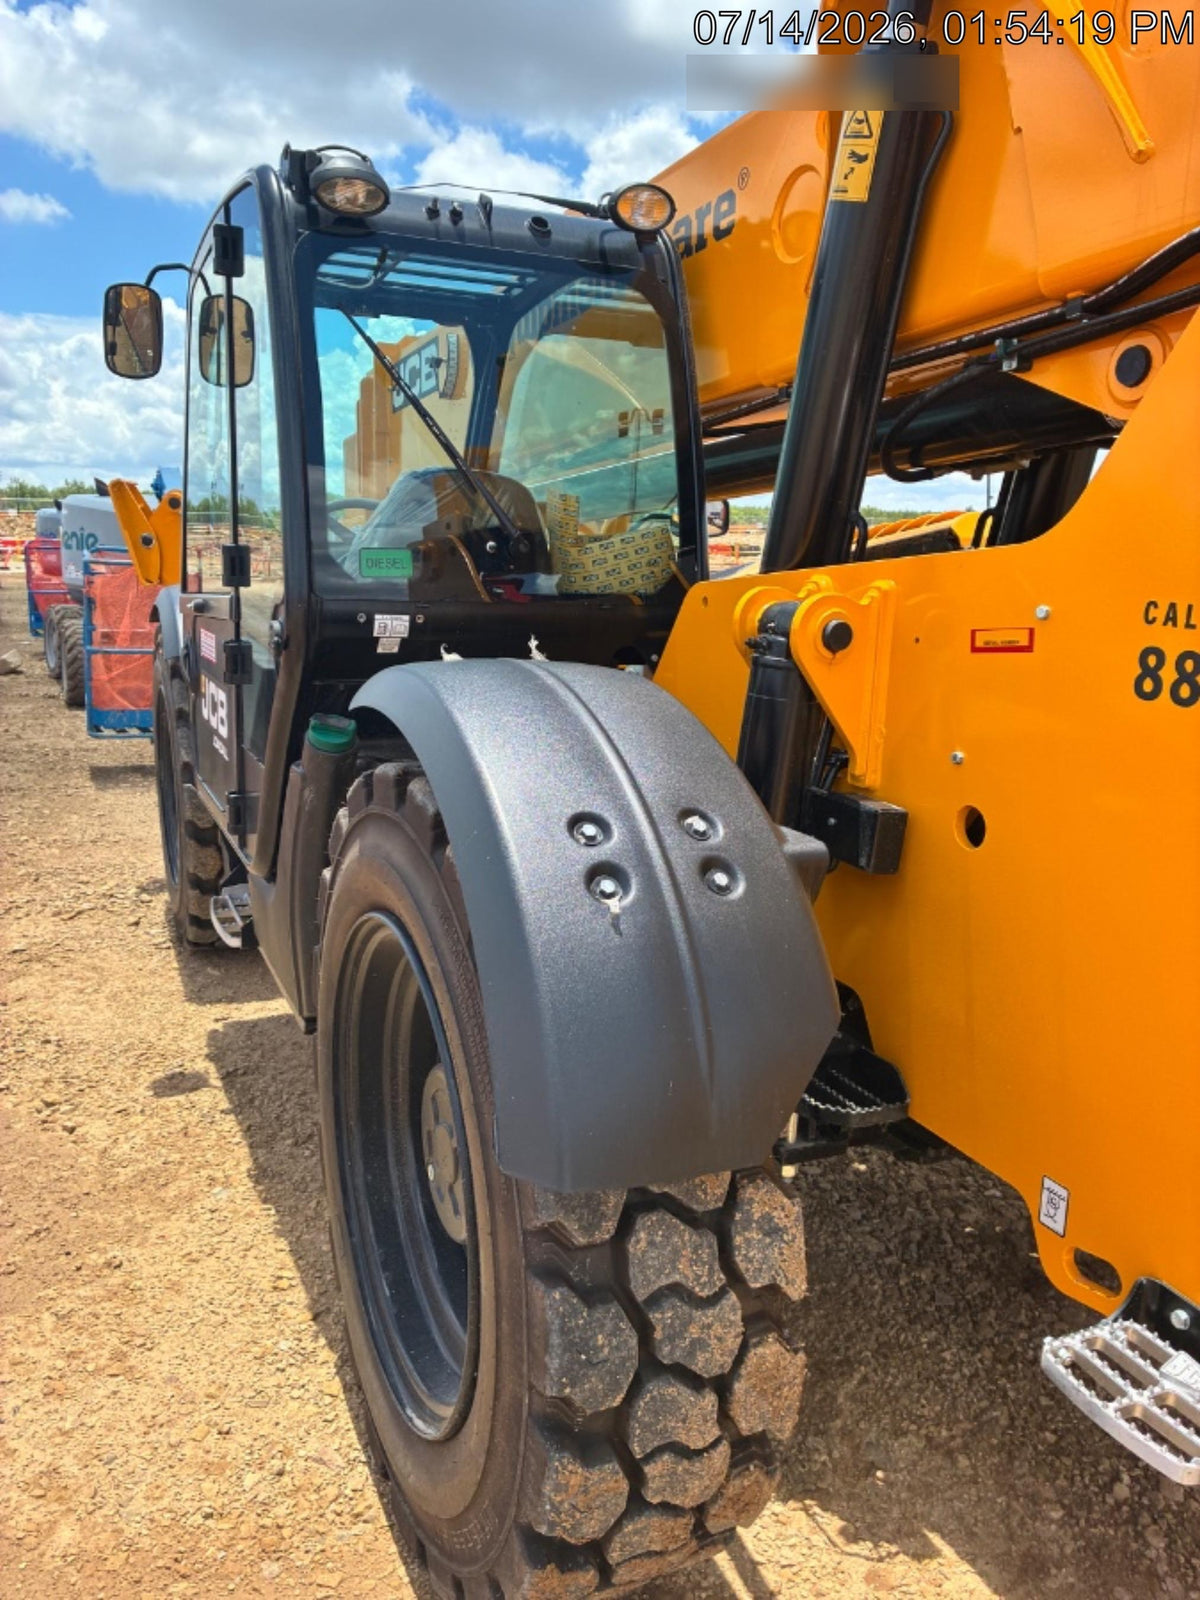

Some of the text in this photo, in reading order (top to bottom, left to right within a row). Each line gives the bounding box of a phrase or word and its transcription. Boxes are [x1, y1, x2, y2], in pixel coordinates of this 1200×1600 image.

[365, 557, 408, 571] DIESEL
[1143, 600, 1198, 630] CAL
[1133, 645, 1200, 708] 88
[201, 674, 229, 739] JCB
